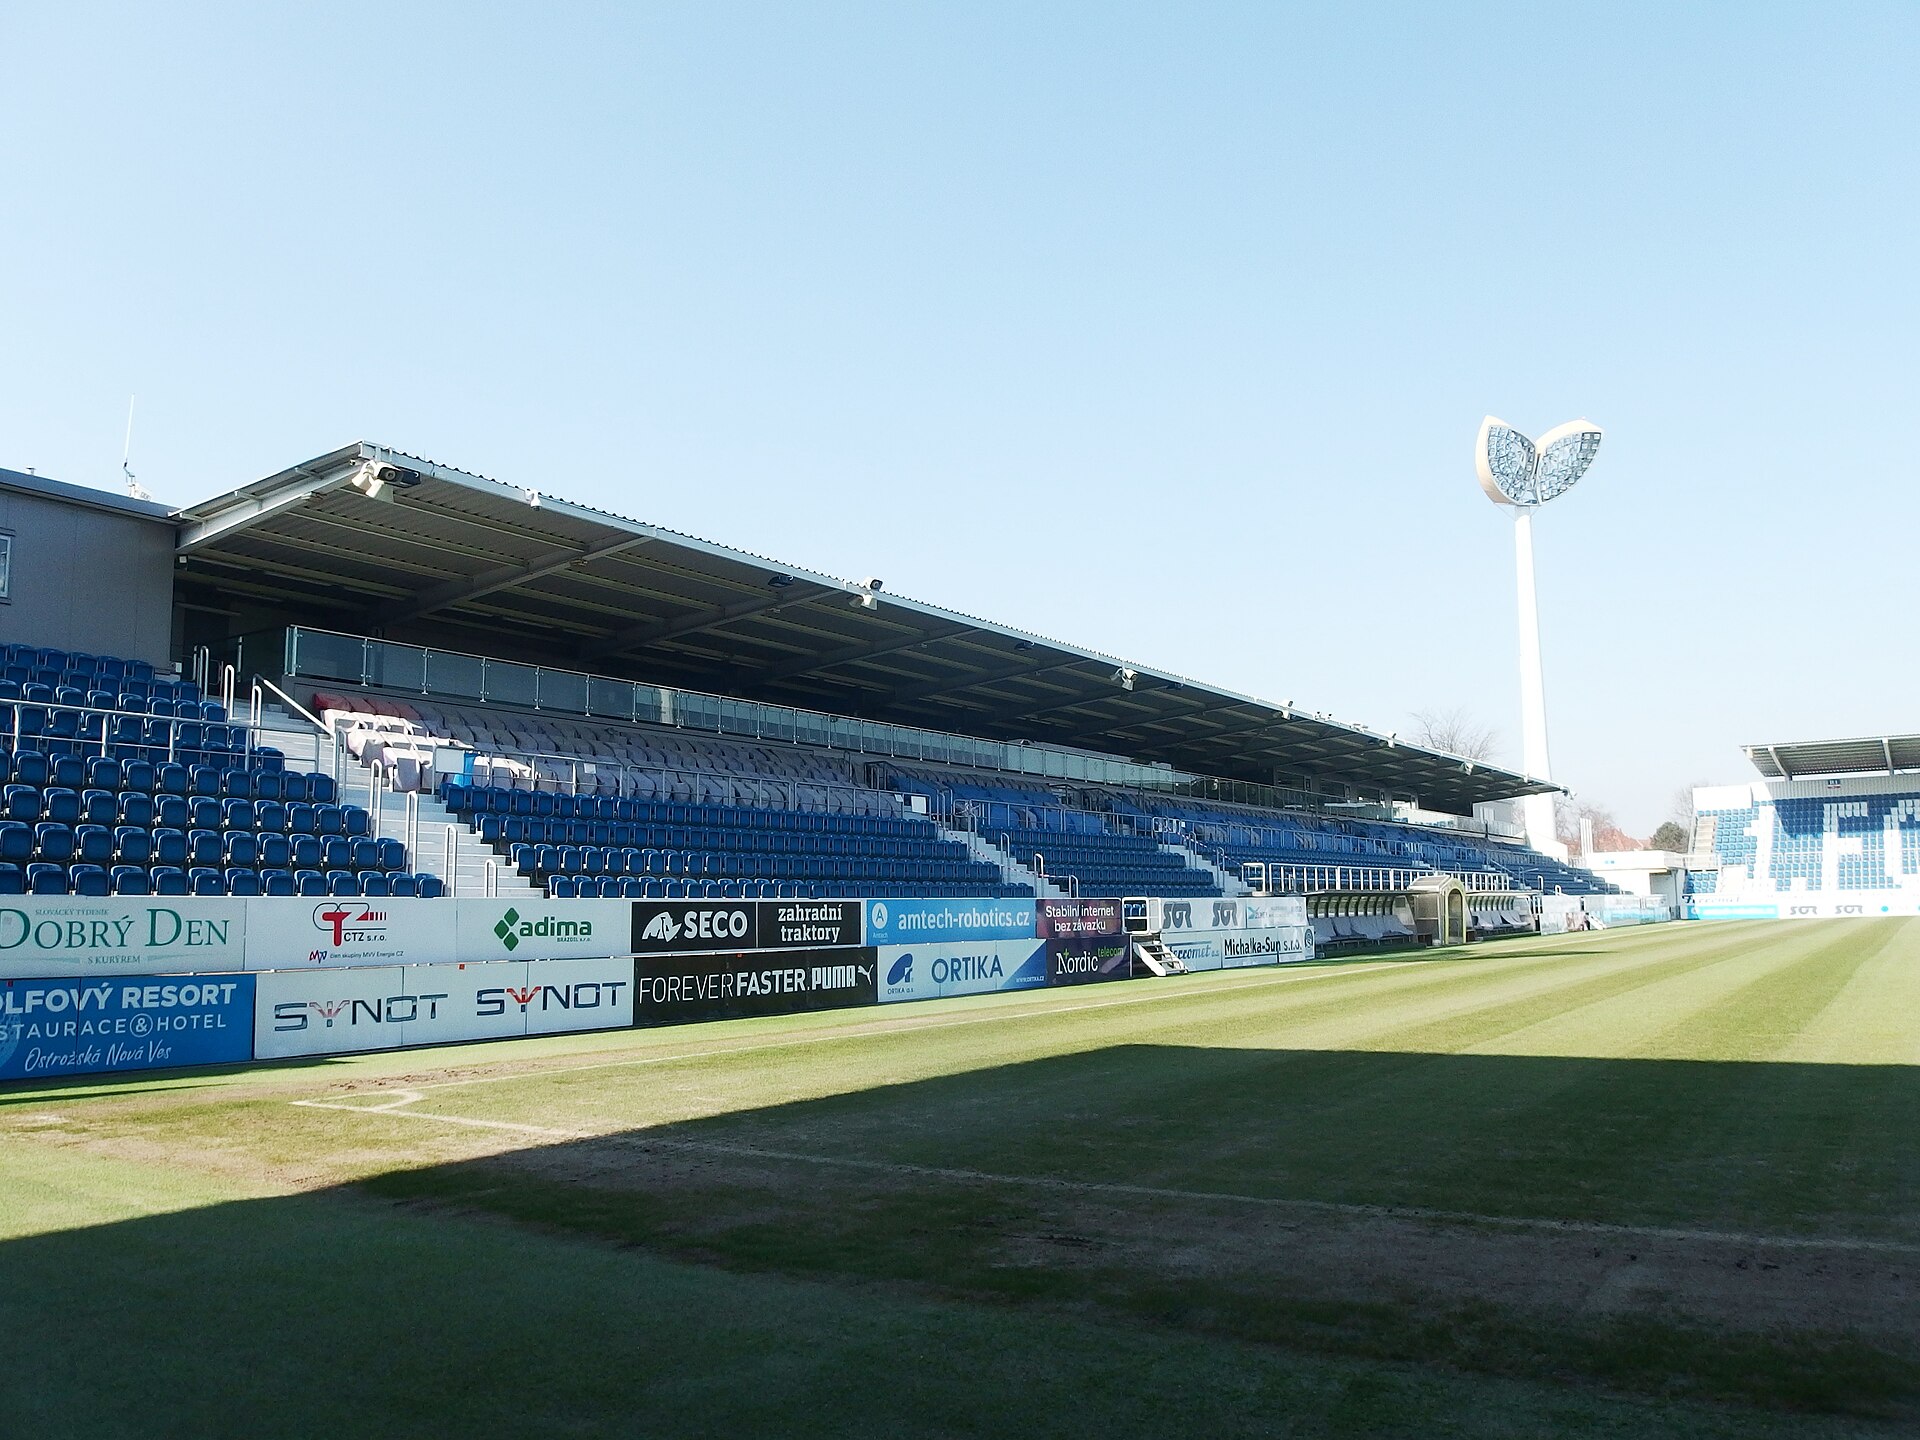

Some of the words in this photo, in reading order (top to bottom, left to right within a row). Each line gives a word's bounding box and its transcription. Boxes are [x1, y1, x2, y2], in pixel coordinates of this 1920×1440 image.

[778, 903, 843, 922] zahradní
[898, 907, 1030, 930] amtech-robotics.cz
[1045, 904, 1080, 918] Stabilní
[1081, 904, 1115, 917] internet
[343, 932, 365, 942] CTZ
[366, 934, 387, 942] s.r.o.
[519, 916, 593, 937] adima
[683, 910, 748, 939] SECO
[780, 924, 841, 944] traktory
[1054, 919, 1072, 932] bez
[1072, 918, 1107, 931] závazku
[931, 954, 1004, 984] ORTIKA
[1055, 950, 1099, 975] Nordic
[1097, 946, 1125, 957] telecom
[639, 973, 734, 1004] FOREVER
[811, 964, 856, 991] PUMA
[0, 982, 114, 1014] LFOVÝ
[121, 983, 237, 1009] RESORT
[476, 981, 627, 1016] SYNOT
[156, 1014, 227, 1031] HOTEL
[274, 993, 448, 1032] SYNOT
[105, 1041, 144, 1066] Nová
[148, 1039, 172, 1063] Ves
